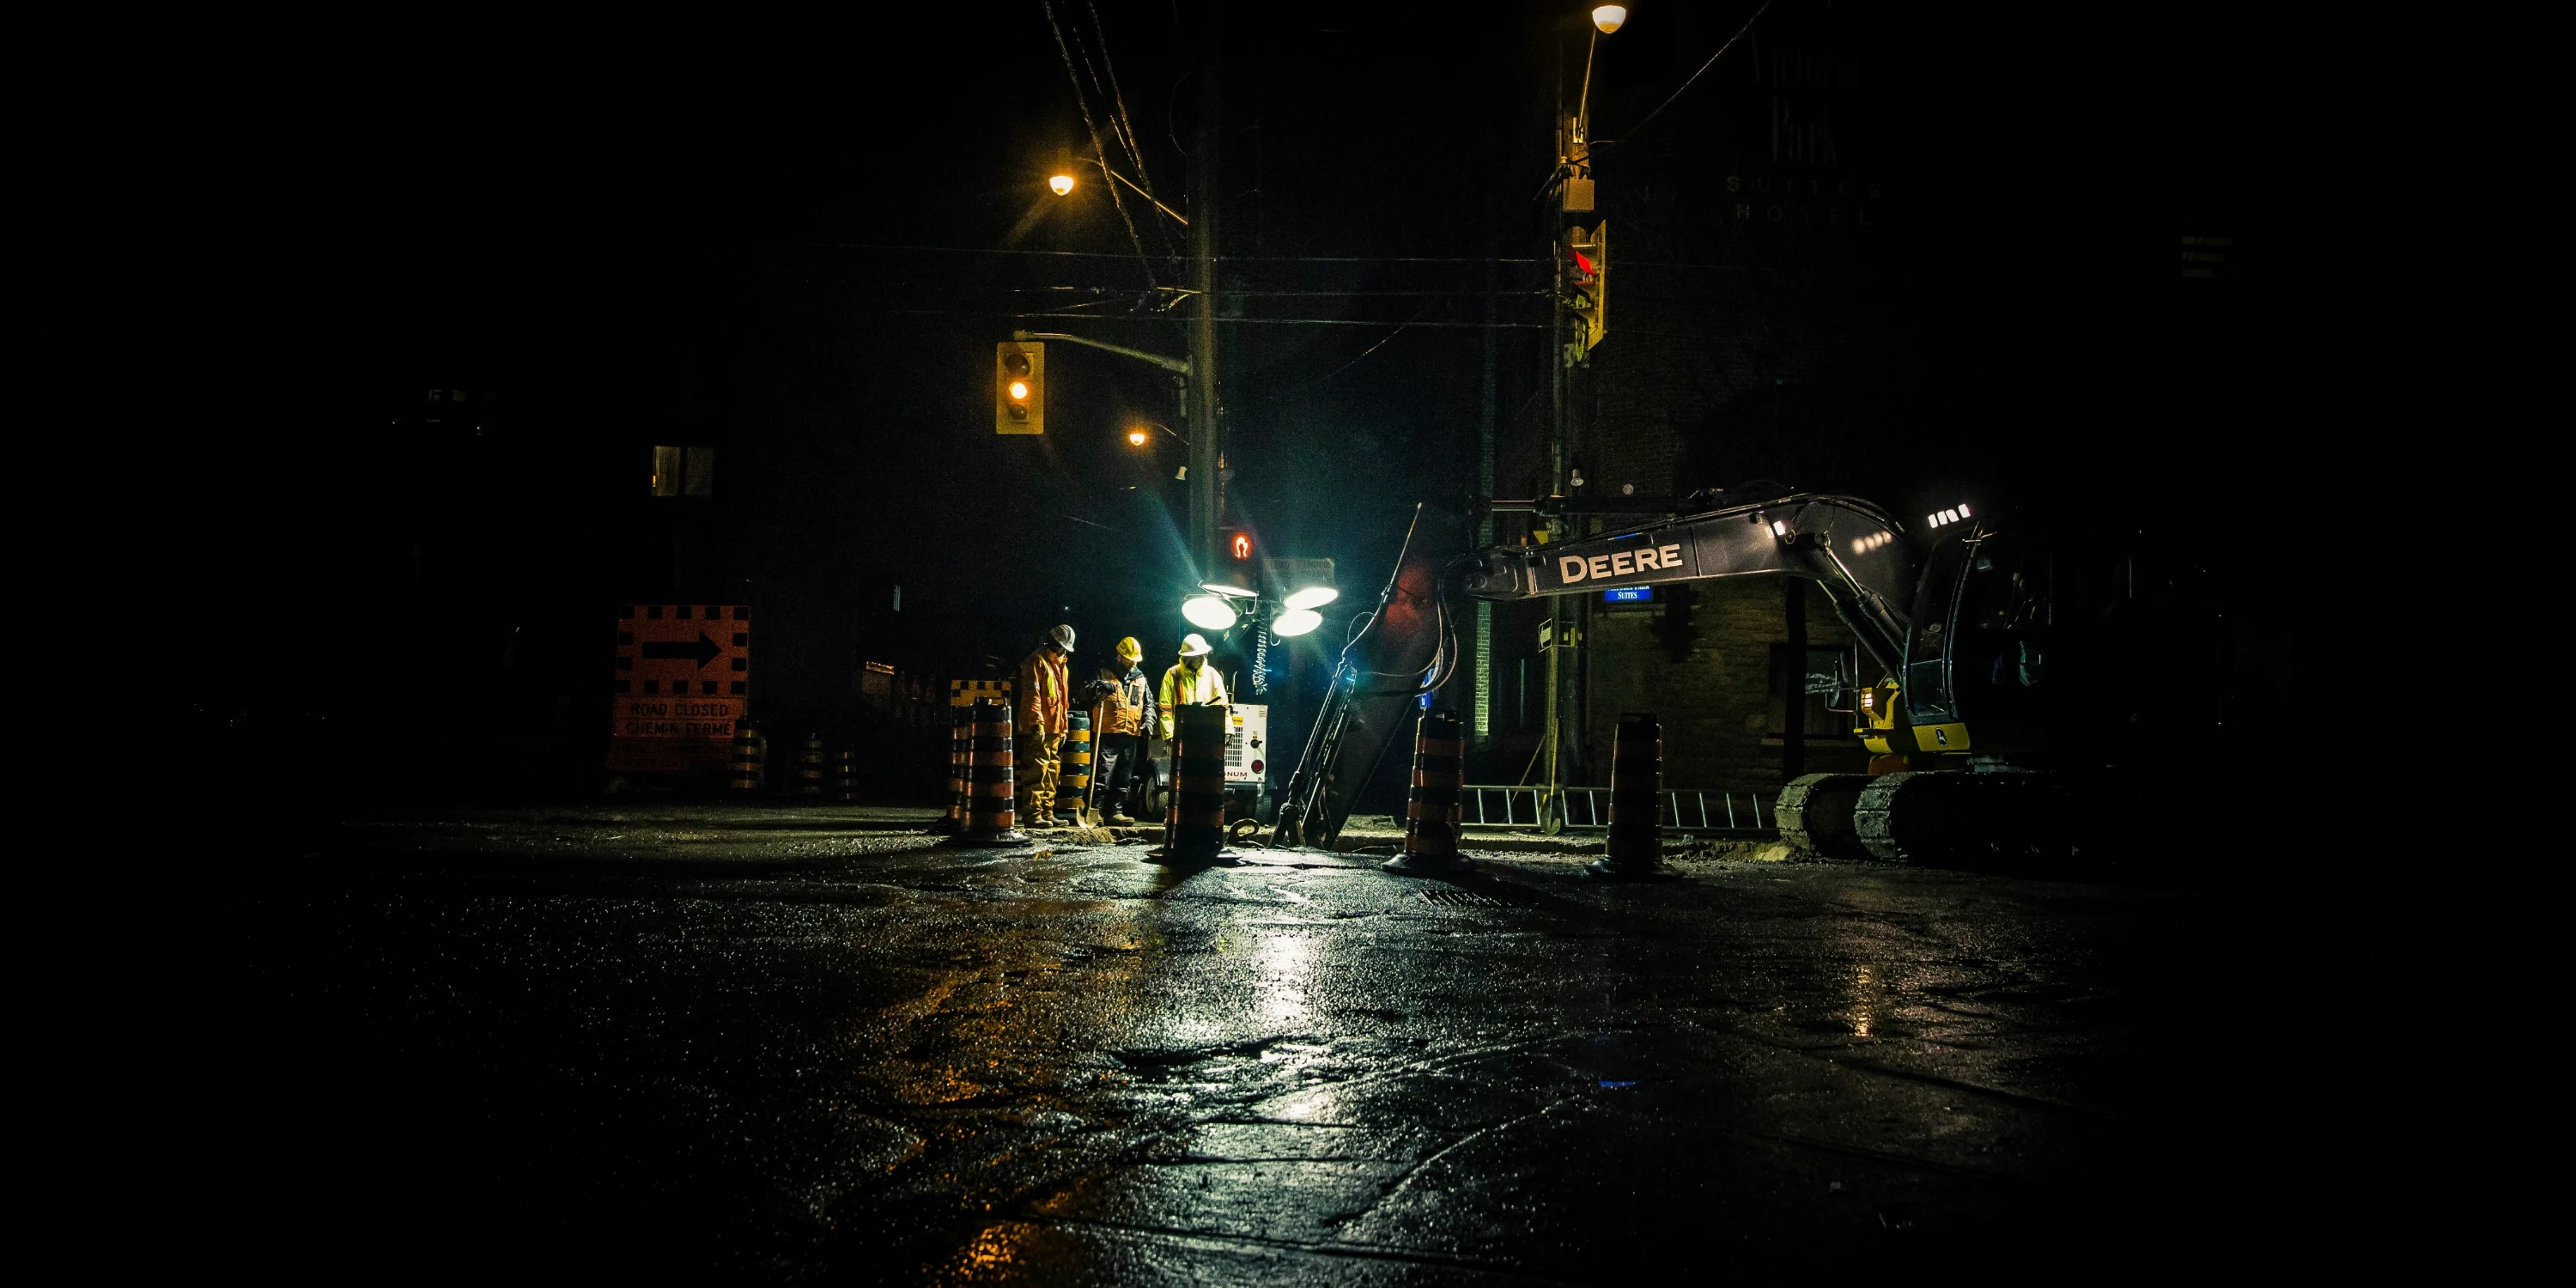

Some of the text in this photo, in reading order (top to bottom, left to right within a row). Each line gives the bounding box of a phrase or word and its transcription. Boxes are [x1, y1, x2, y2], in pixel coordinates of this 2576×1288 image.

[1734, 203, 1872, 228] HOTEL
[1559, 544, 1683, 584] DEERE
[631, 704, 728, 715] ROAD CLOSED
[625, 722, 678, 735] CHEMIN
